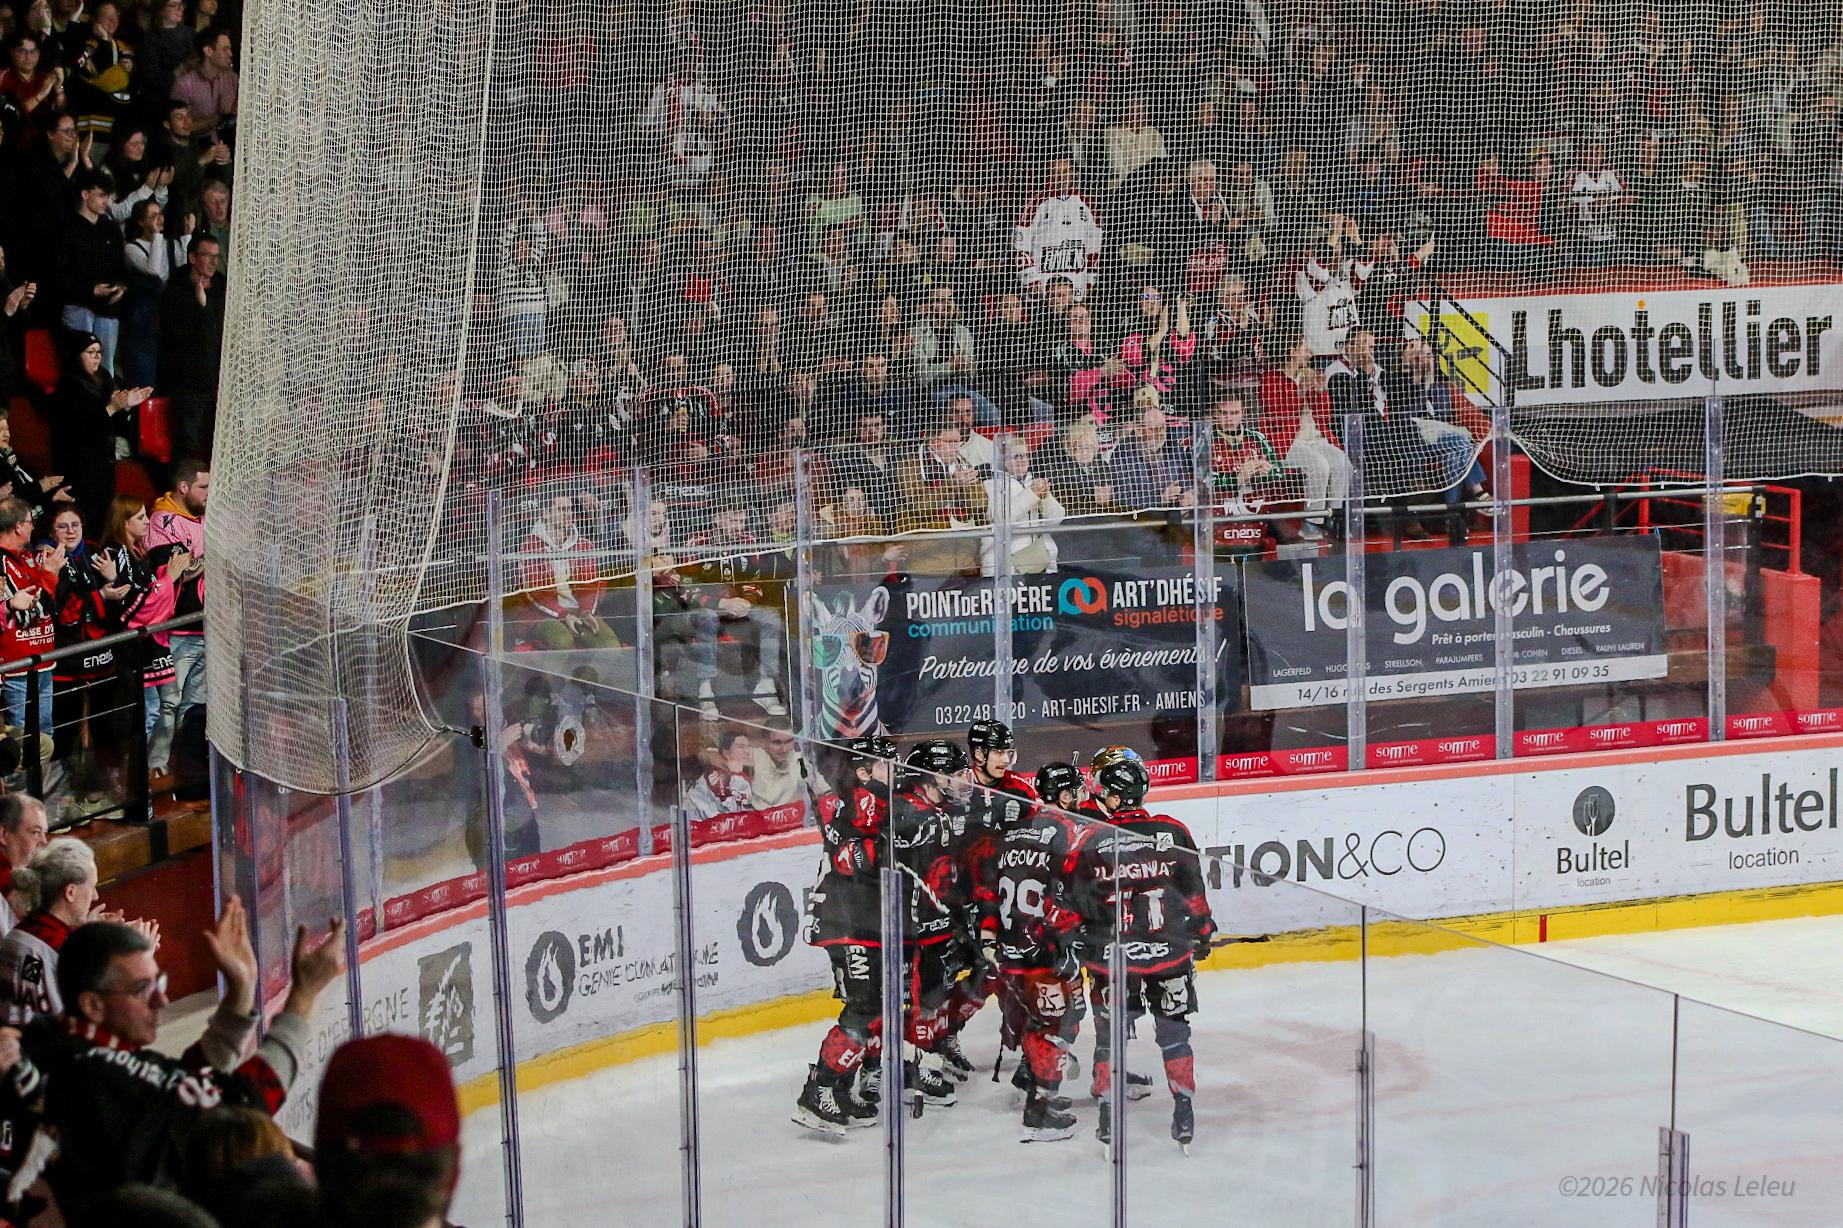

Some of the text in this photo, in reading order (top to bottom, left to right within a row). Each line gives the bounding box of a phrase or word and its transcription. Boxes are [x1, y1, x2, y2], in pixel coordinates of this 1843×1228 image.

[1511, 299, 1833, 391] Lhotellier
[1301, 549, 1610, 645] la galerie
[907, 615, 1055, 638] communiation
[1431, 630, 1454, 646] Prêt
[1455, 631, 1462, 644] à
[1501, 625, 1545, 641] asculin
[1553, 624, 1612, 638] Chaussures
[1032, 648, 1059, 674] de
[1062, 652, 1096, 672] vos
[1369, 682, 1392, 695] des
[1396, 677, 1454, 695] Sergents
[1553, 667, 1567, 680] 91
[1571, 666, 1589, 679] 09
[1593, 664, 1609, 678] 35
[1041, 694, 1141, 718] ART-DHESIF.FR
[1155, 690, 1206, 711] AMIENS
[1522, 731, 1564, 746] somme
[1589, 726, 1631, 741] somme
[1656, 721, 1697, 736] somme
[1289, 750, 1333, 765] somme
[1375, 744, 1418, 759] somme
[1438, 738, 1480, 754] somme
[1225, 755, 1269, 771] somme
[1685, 767, 1839, 842] Bultel
[1556, 839, 1630, 875] Bultel
[1728, 845, 1800, 870] location
[1576, 875, 1611, 888] location
[577, 924, 624, 968] EMI
